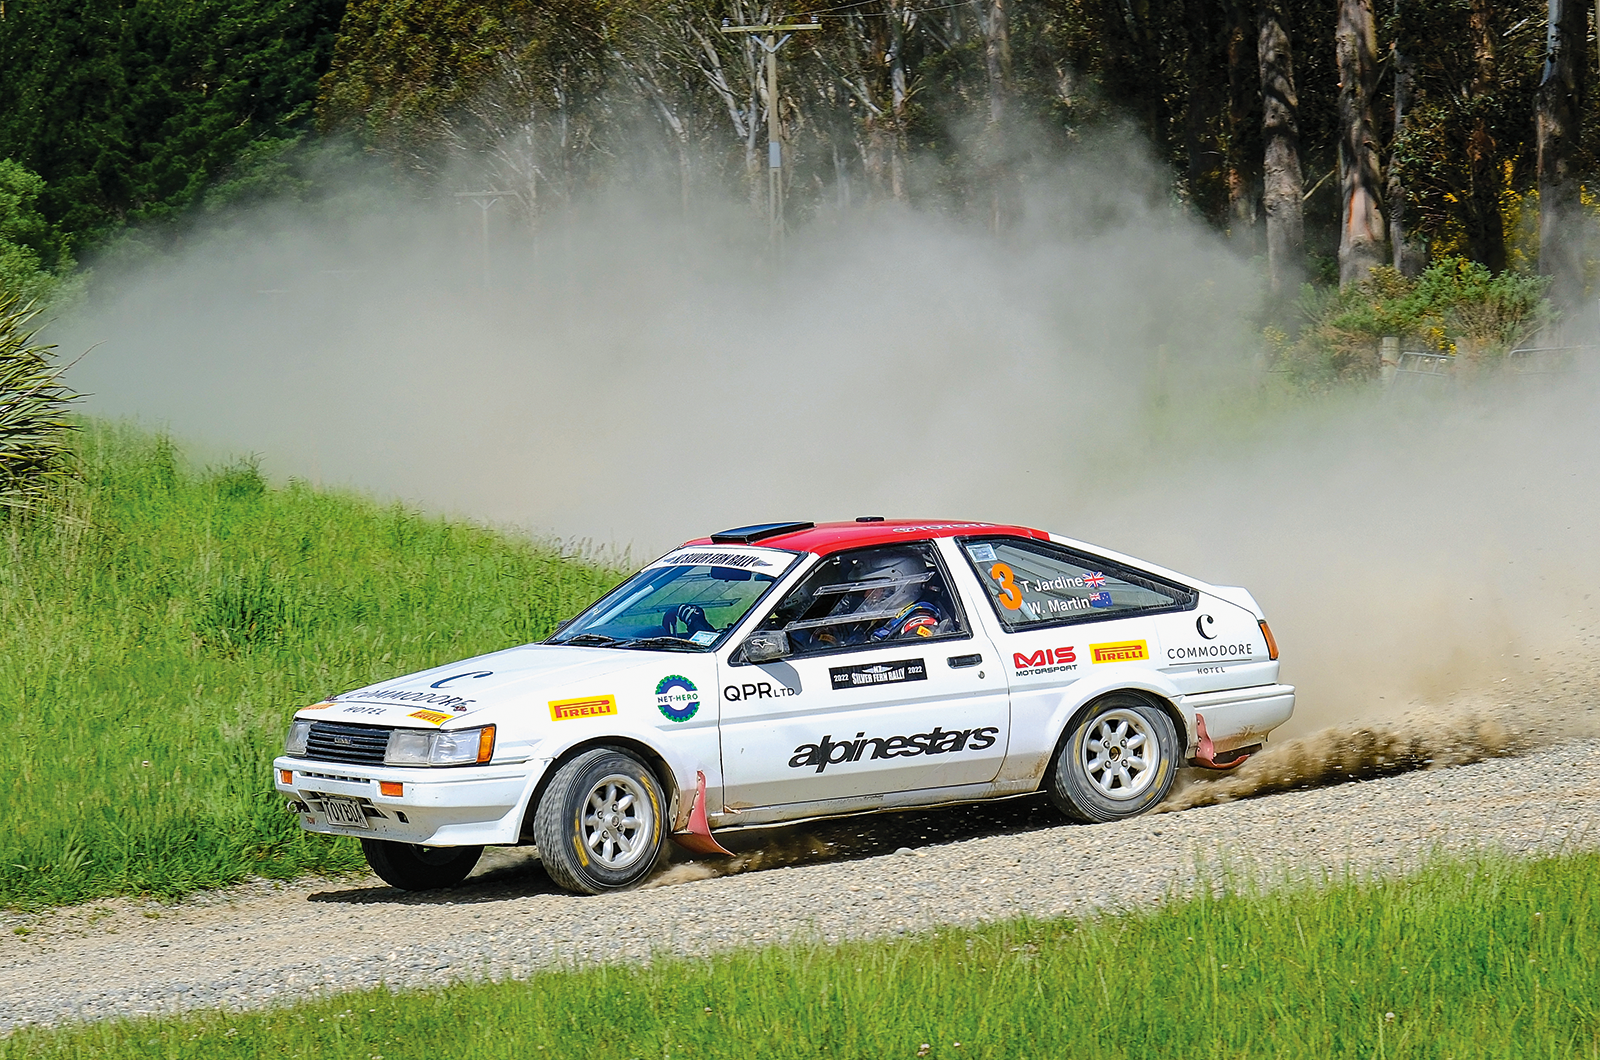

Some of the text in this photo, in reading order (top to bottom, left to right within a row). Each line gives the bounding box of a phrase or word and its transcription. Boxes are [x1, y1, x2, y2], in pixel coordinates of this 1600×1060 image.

[990, 563, 1023, 611] 3
[1020, 575, 1084, 593] T Jardine
[1029, 596, 1090, 615] W. Martin
[1196, 614, 1218, 640] C
[1013, 646, 1077, 670] MIS
[1094, 645, 1144, 662] PIRELLI
[1167, 643, 1253, 660] COMMODORE
[833, 665, 923, 685] 2022 SILVER FERN RALLY 2022
[1015, 664, 1078, 677] MOTORSPORT
[1197, 666, 1226, 675] HOTEL
[657, 693, 698, 704] NET-HERO
[723, 682, 795, 701] QPR LTD
[343, 705, 388, 716] HOTEL
[554, 699, 611, 718] PIRELLI
[788, 727, 1000, 774] alpinestars
